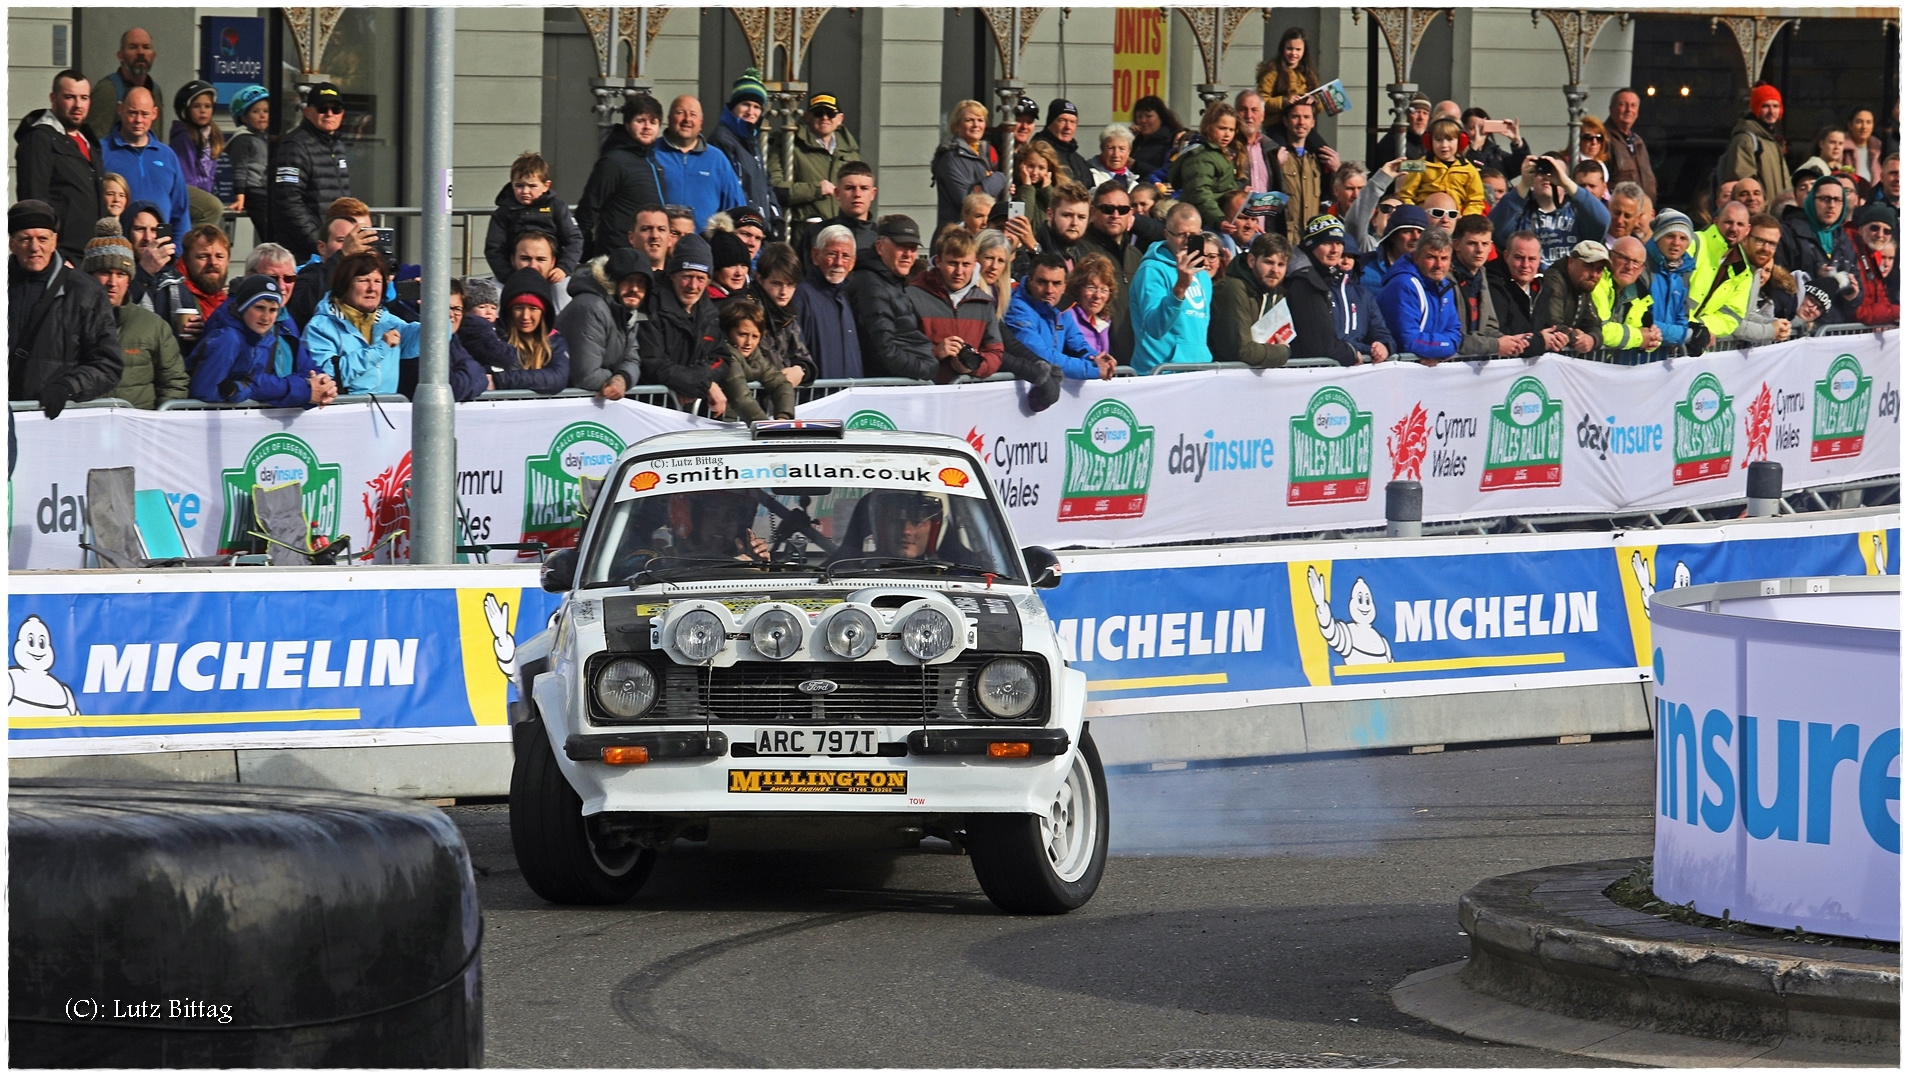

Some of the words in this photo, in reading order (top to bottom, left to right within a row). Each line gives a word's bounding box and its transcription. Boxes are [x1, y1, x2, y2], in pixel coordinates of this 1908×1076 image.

[1114, 8, 1162, 55] UNITS
[213, 55, 261, 78] Travelodge
[1113, 69, 1132, 112] TO
[1776, 388, 1805, 422] Cymru
[1094, 427, 1126, 444] dayinsure
[1316, 414, 1347, 429] dayinsure
[1435, 411, 1477, 446] Cymru
[556, 433, 574, 453] RALLY
[576, 430, 585, 438] OF
[586, 430, 619, 450] LEGENDS
[1490, 416, 1520, 464] WALES
[1520, 420, 1547, 462] RALLY
[1577, 413, 1662, 460] dayinsure
[1776, 424, 1800, 452] Wales
[252, 446, 270, 467] RALLY
[272, 442, 281, 451] OF
[282, 443, 311, 464] LEGENDS
[565, 452, 613, 470] dayinsure
[994, 436, 1048, 475] Cymru
[1168, 429, 1274, 483] dayinsure
[1294, 426, 1326, 477] WALES
[1328, 433, 1356, 475] RALLY
[1432, 450, 1467, 477] Wales
[260, 466, 304, 484] dayinsure
[666, 464, 931, 484] smithandallan.co.uk
[1068, 440, 1106, 492] WALES
[1103, 448, 1137, 491] RALLY
[1394, 590, 1598, 643] MICHELIN
[82, 638, 419, 694] MICHELIN
[806, 681, 829, 692] Ford
[758, 730, 804, 752] ARC
[812, 730, 875, 752] 797T
[729, 770, 906, 792] MILLINGTON
